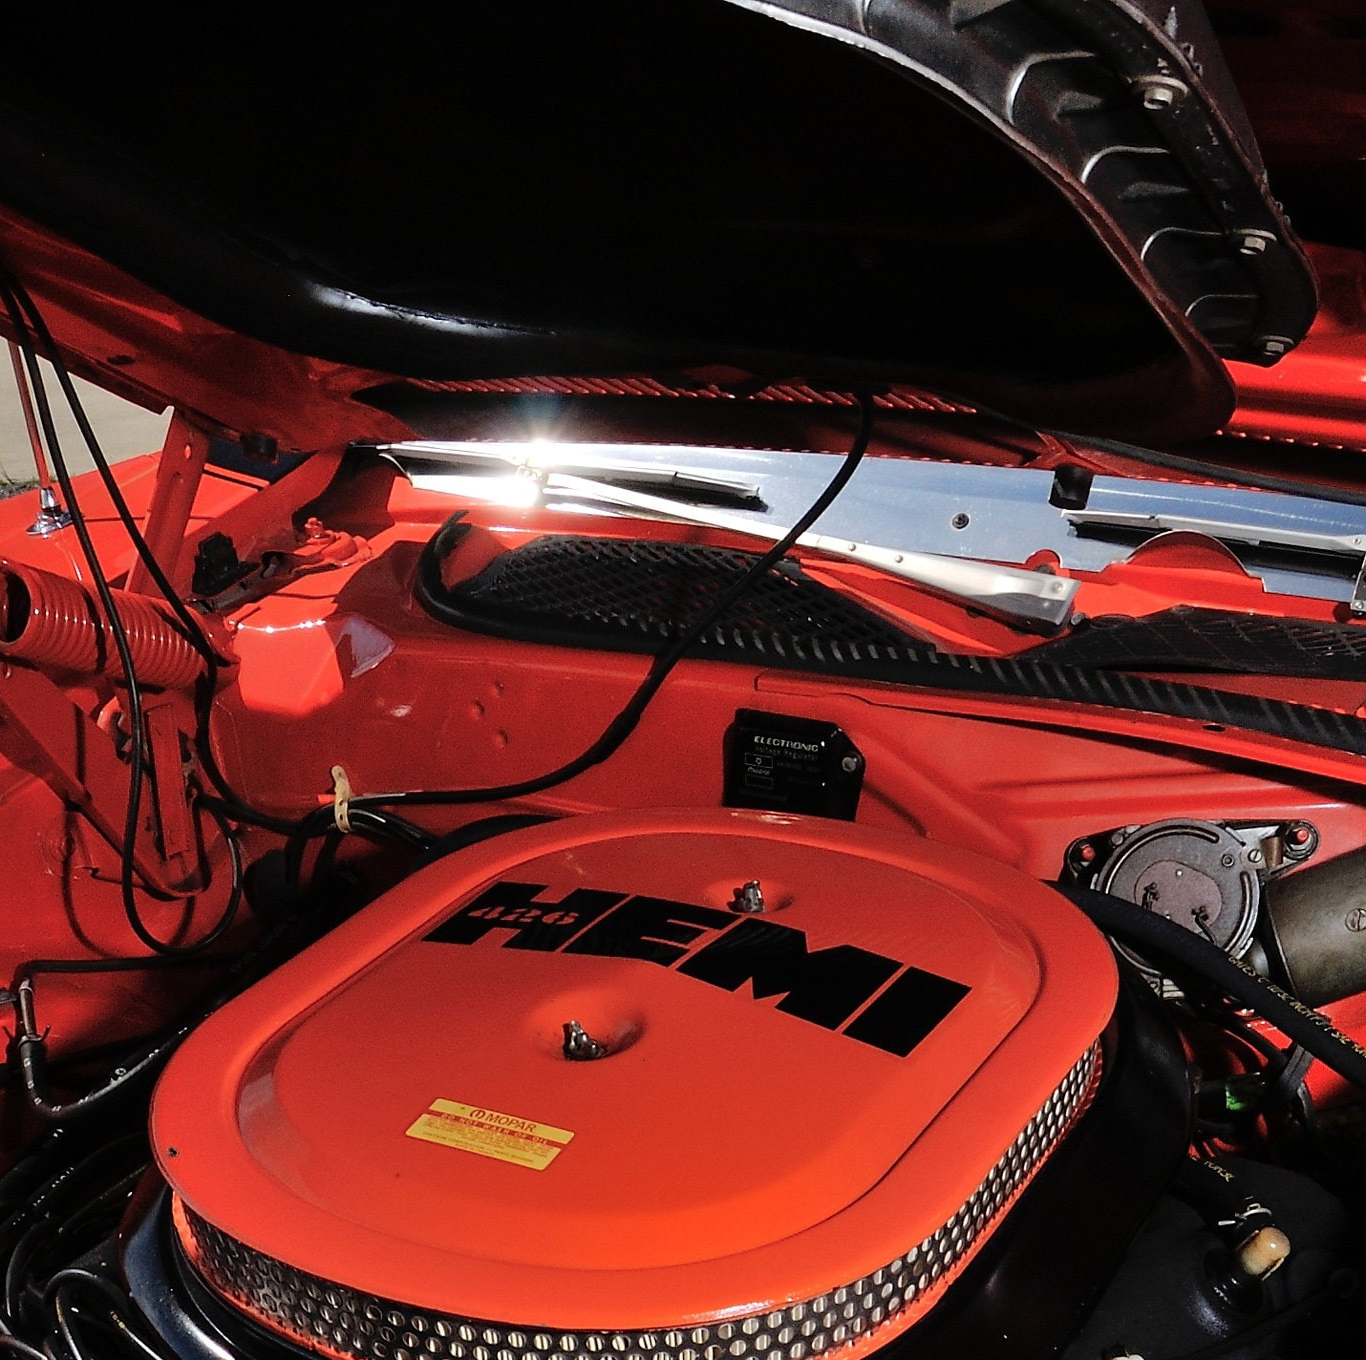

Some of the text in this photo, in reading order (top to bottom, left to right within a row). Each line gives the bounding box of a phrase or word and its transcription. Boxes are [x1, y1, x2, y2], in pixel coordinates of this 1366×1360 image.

[753, 735, 819, 752] ELECTRONIC
[467, 905, 579, 926] 426
[420, 881, 973, 1058] HEMI
[485, 1112, 537, 1133] MOPAR
